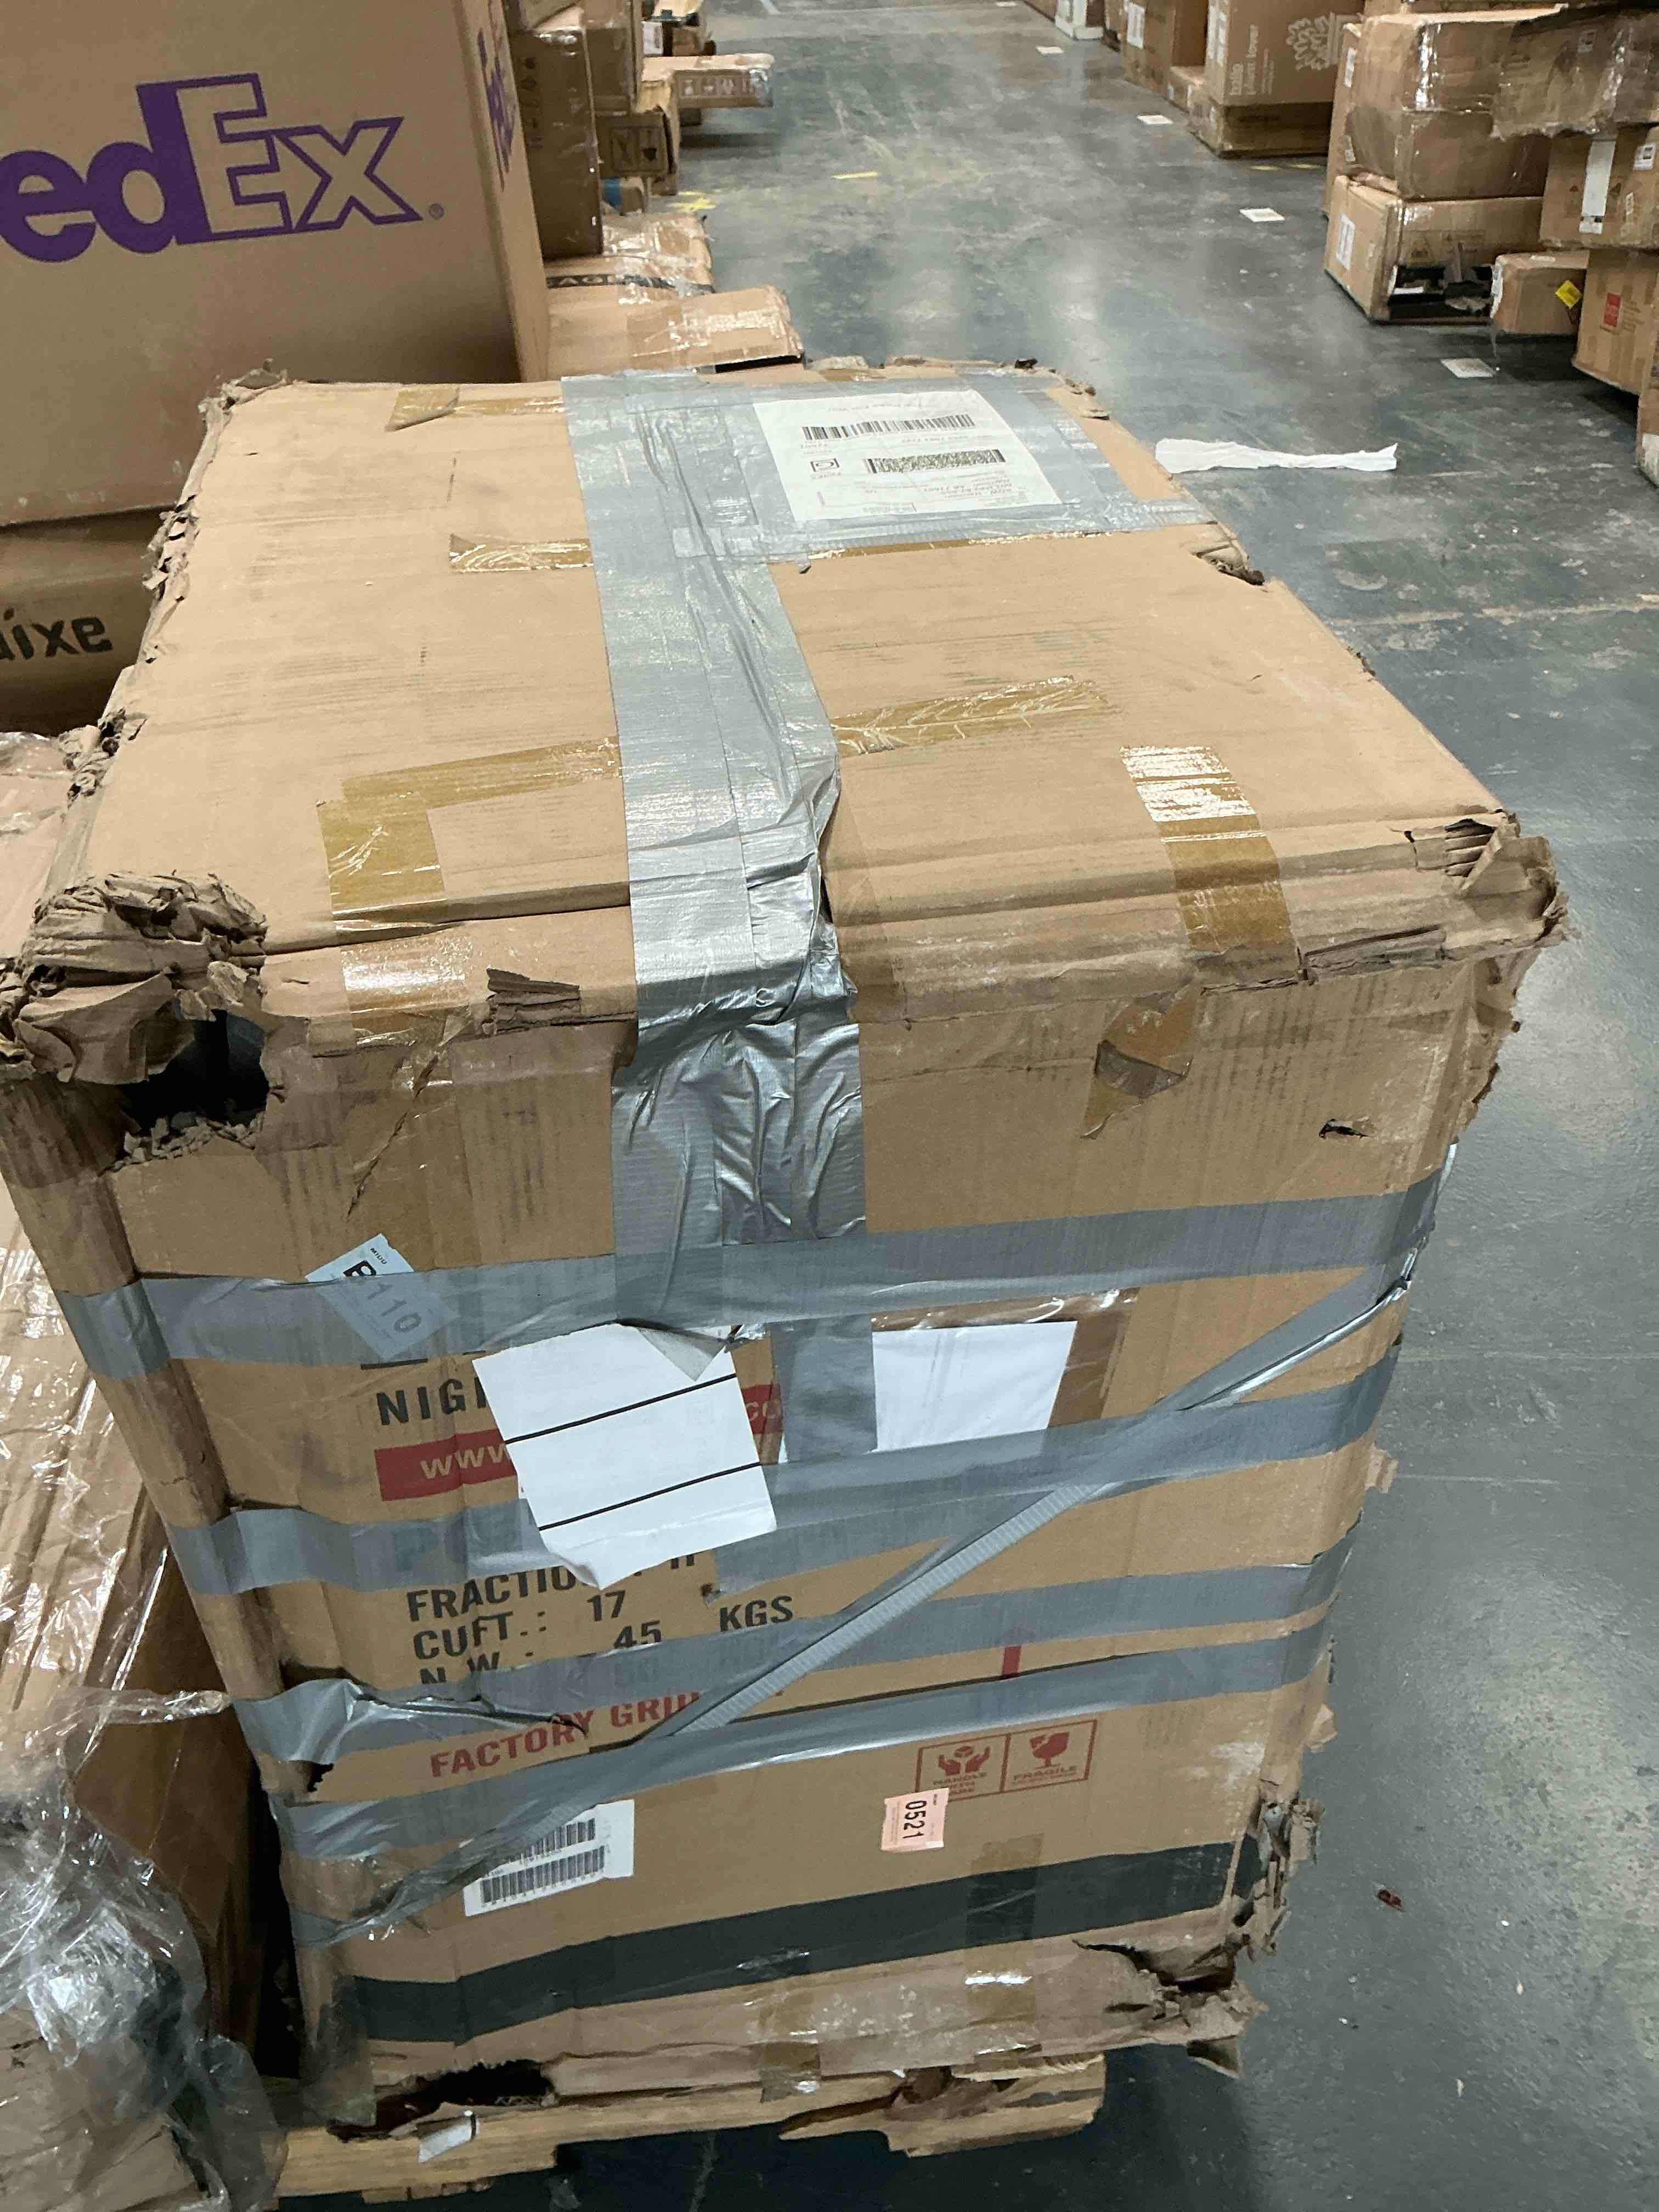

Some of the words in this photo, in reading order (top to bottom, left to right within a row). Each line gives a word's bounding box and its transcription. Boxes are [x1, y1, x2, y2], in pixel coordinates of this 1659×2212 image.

[0, 72, 422, 262] edEx
[407, 1565, 576, 1622] FRACTIO
[586, 1589, 626, 1622] 17
[613, 1620, 662, 1649] 45
[719, 1595, 794, 1633] KGS
[430, 1709, 595, 1778] FACTORY
[902, 1800, 927, 1839] 0521
